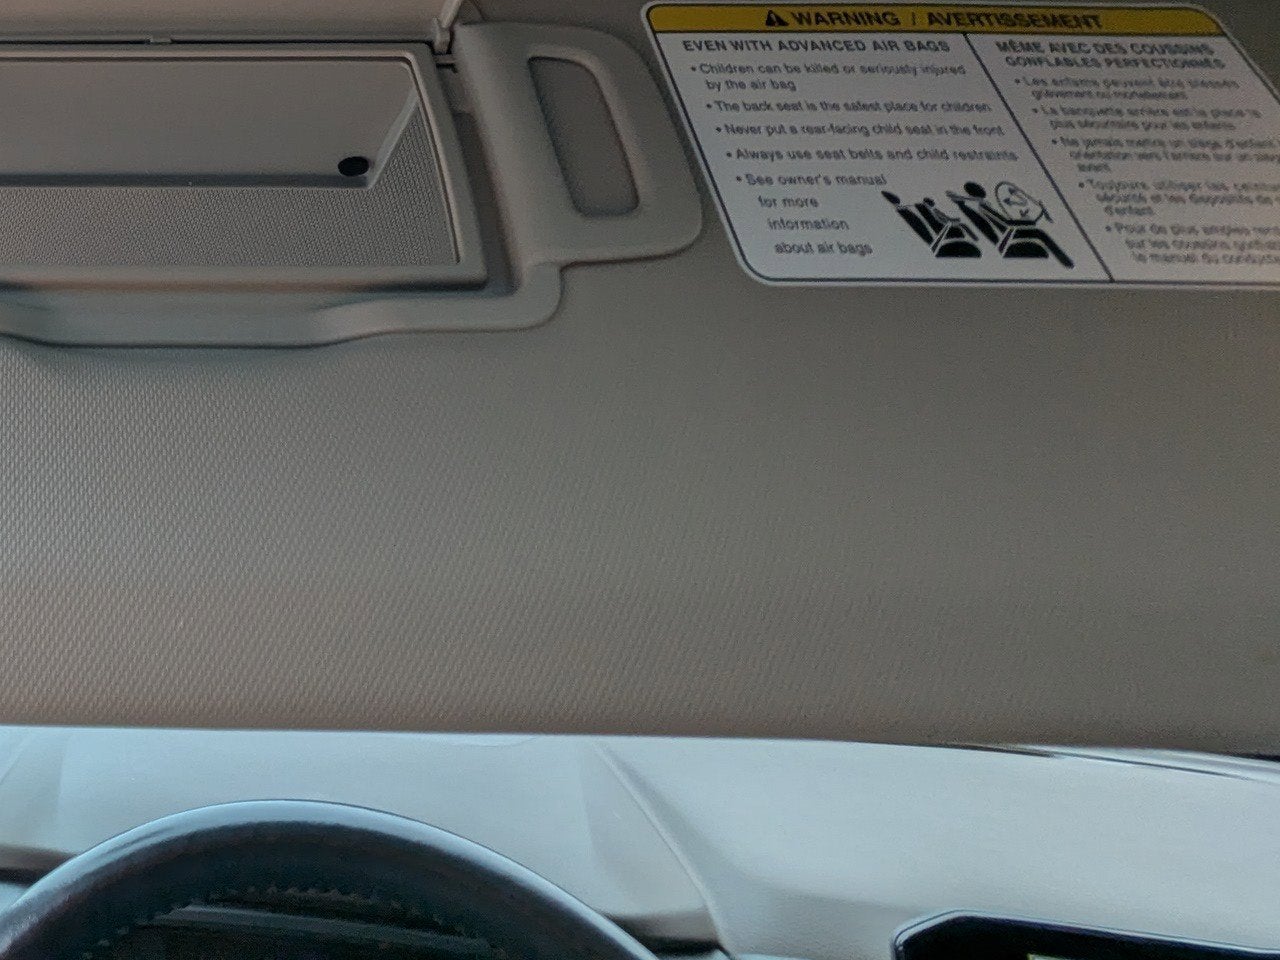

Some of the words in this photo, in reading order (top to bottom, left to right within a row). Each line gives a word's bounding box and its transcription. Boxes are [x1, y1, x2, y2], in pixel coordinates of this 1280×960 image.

[791, 11, 901, 26] WARNING
[927, 12, 1103, 29] AVERTISSEMENT
[682, 39, 728, 52] EVEN
[729, 39, 774, 52] WITH
[778, 39, 867, 52] ADVANCED
[872, 39, 901, 52] AIR
[903, 40, 951, 53] BAGS
[1049, 41, 1092, 55] AVEC
[1093, 42, 1128, 55] DES
[699, 62, 754, 75] Children
[757, 65, 782, 75] can
[783, 63, 802, 75] be
[804, 62, 840, 75] killed
[842, 65, 856, 75] or
[859, 64, 918, 77] seriously
[919, 64, 967, 77] injured
[705, 78, 721, 93] by
[724, 78, 747, 90] the
[750, 78, 767, 91] air
[770, 78, 797, 92] bag
[713, 99, 741, 113] The
[742, 100, 773, 112] back
[775, 101, 804, 112] seat
[805, 100, 818, 112] is
[819, 100, 841, 112] the
[843, 100, 882, 112] safest
[883, 101, 919, 114] place
[919, 100, 939, 112] for
[724, 123, 763, 136] Never
[764, 123, 788, 138] put
[789, 126, 799, 136] a
[800, 123, 872, 138] rear-facing
[871, 123, 903, 136] child
[904, 124, 933, 136] seat
[934, 124, 949, 136] in
[948, 124, 972, 136] the
[736, 148, 784, 163] Always
[786, 150, 813, 161] use
[815, 149, 847, 161] seat
[848, 147, 884, 161] belts
[886, 149, 914, 161] and
[916, 148, 950, 161] child
[744, 173, 775, 186] See
[777, 174, 833, 186] owner's
[835, 174, 888, 186] manual
[757, 194, 778, 208] for
[781, 196, 820, 208] more
[766, 217, 850, 230] information
[774, 242, 815, 254] about
[816, 242, 835, 254] air
[836, 241, 874, 257] bags
